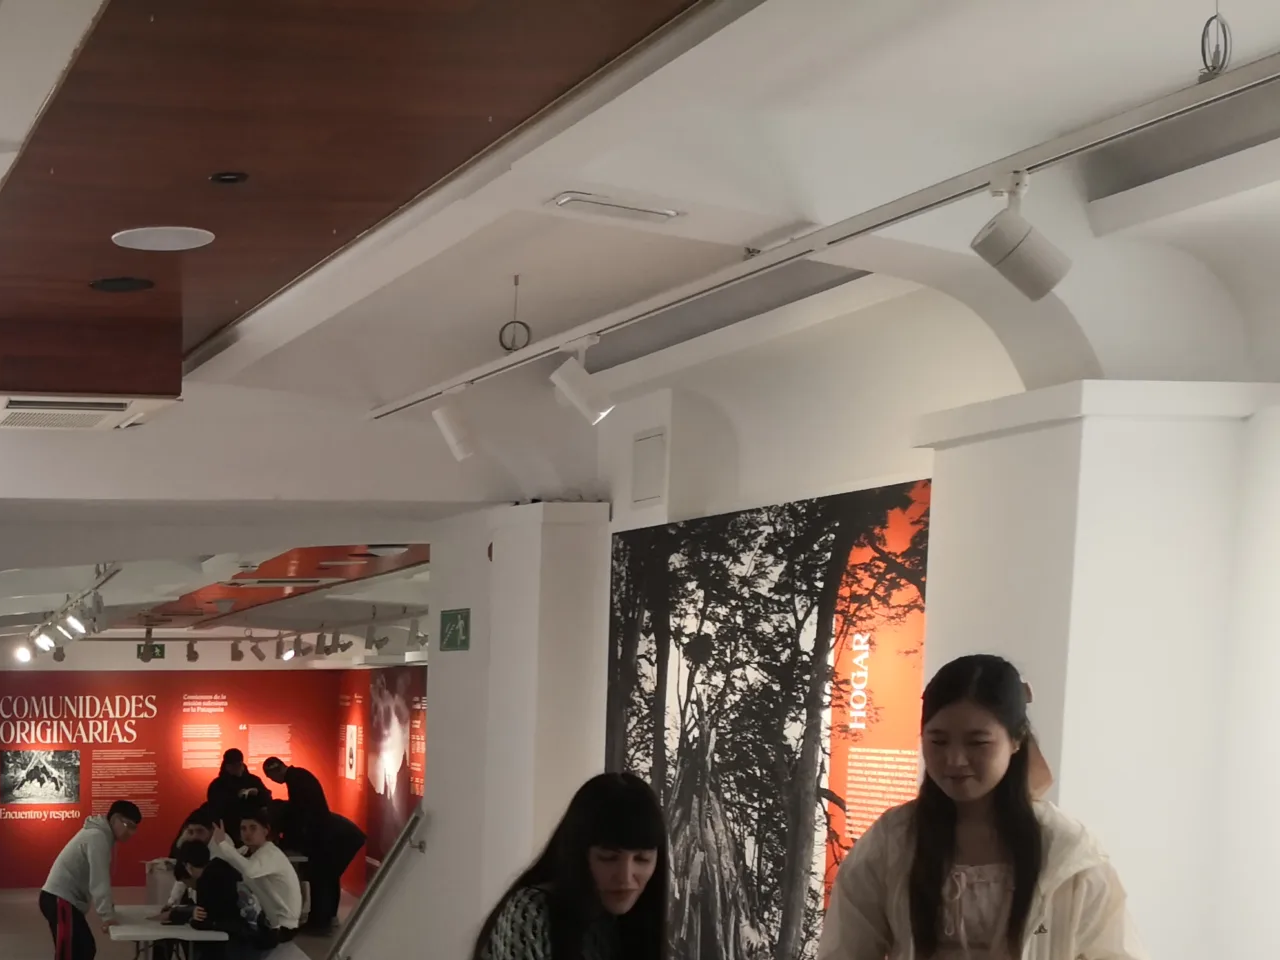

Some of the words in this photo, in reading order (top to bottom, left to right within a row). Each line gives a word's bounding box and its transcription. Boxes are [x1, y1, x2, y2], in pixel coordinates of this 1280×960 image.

[849, 633, 870, 729] HOGAR
[0, 695, 158, 719] COMUNIDADES
[0, 720, 138, 743] ORIGINARIAS
[0, 808, 42, 819] Encuentro
[42, 811, 49, 821] y
[49, 810, 80, 821] respeto
